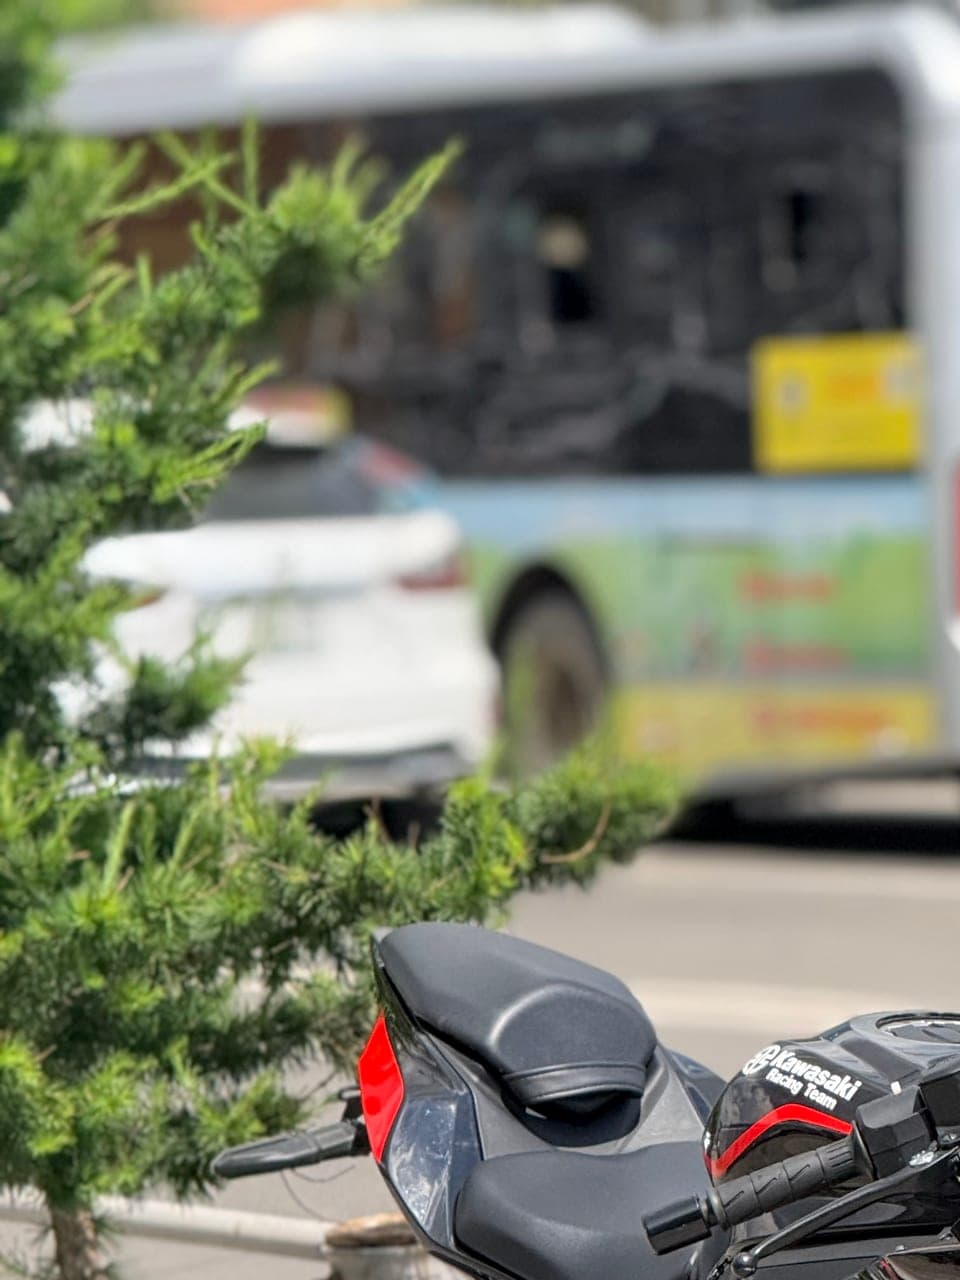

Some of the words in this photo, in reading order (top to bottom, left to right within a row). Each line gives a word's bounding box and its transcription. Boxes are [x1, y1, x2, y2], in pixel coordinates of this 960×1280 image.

[765, 1068, 804, 1095] Racing
[803, 1083, 837, 1110] Team
[769, 1050, 862, 1100] Kawasaki
